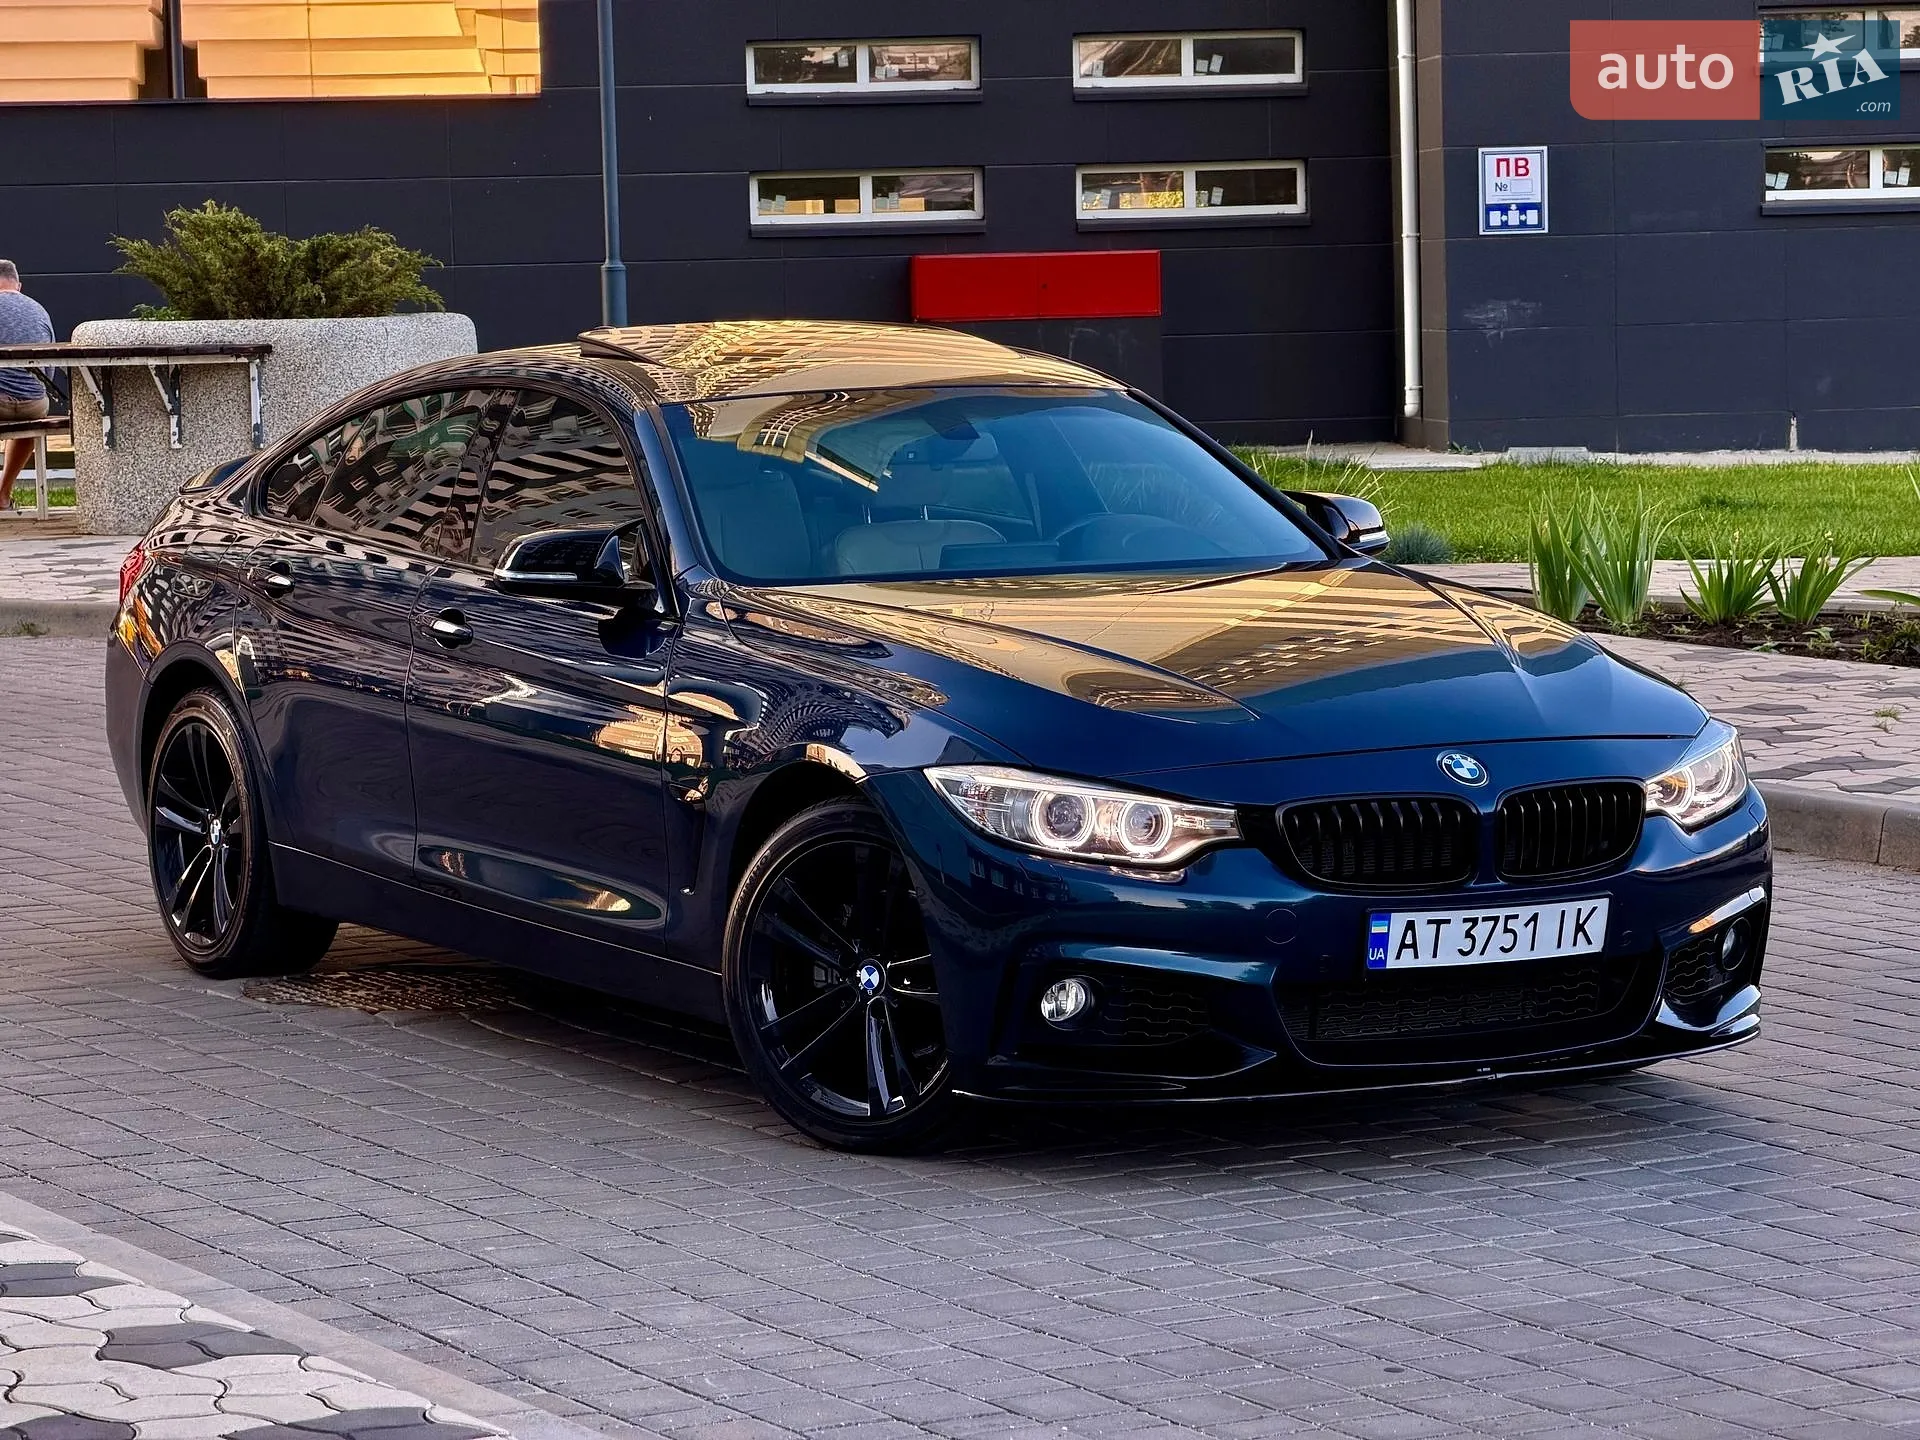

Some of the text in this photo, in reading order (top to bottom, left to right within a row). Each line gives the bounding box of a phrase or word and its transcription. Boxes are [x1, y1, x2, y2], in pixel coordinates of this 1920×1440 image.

[1496, 157, 1530, 177] ПВ
[1395, 905, 1599, 960] AT 3751 IK
[1369, 947, 1385, 961] UA
